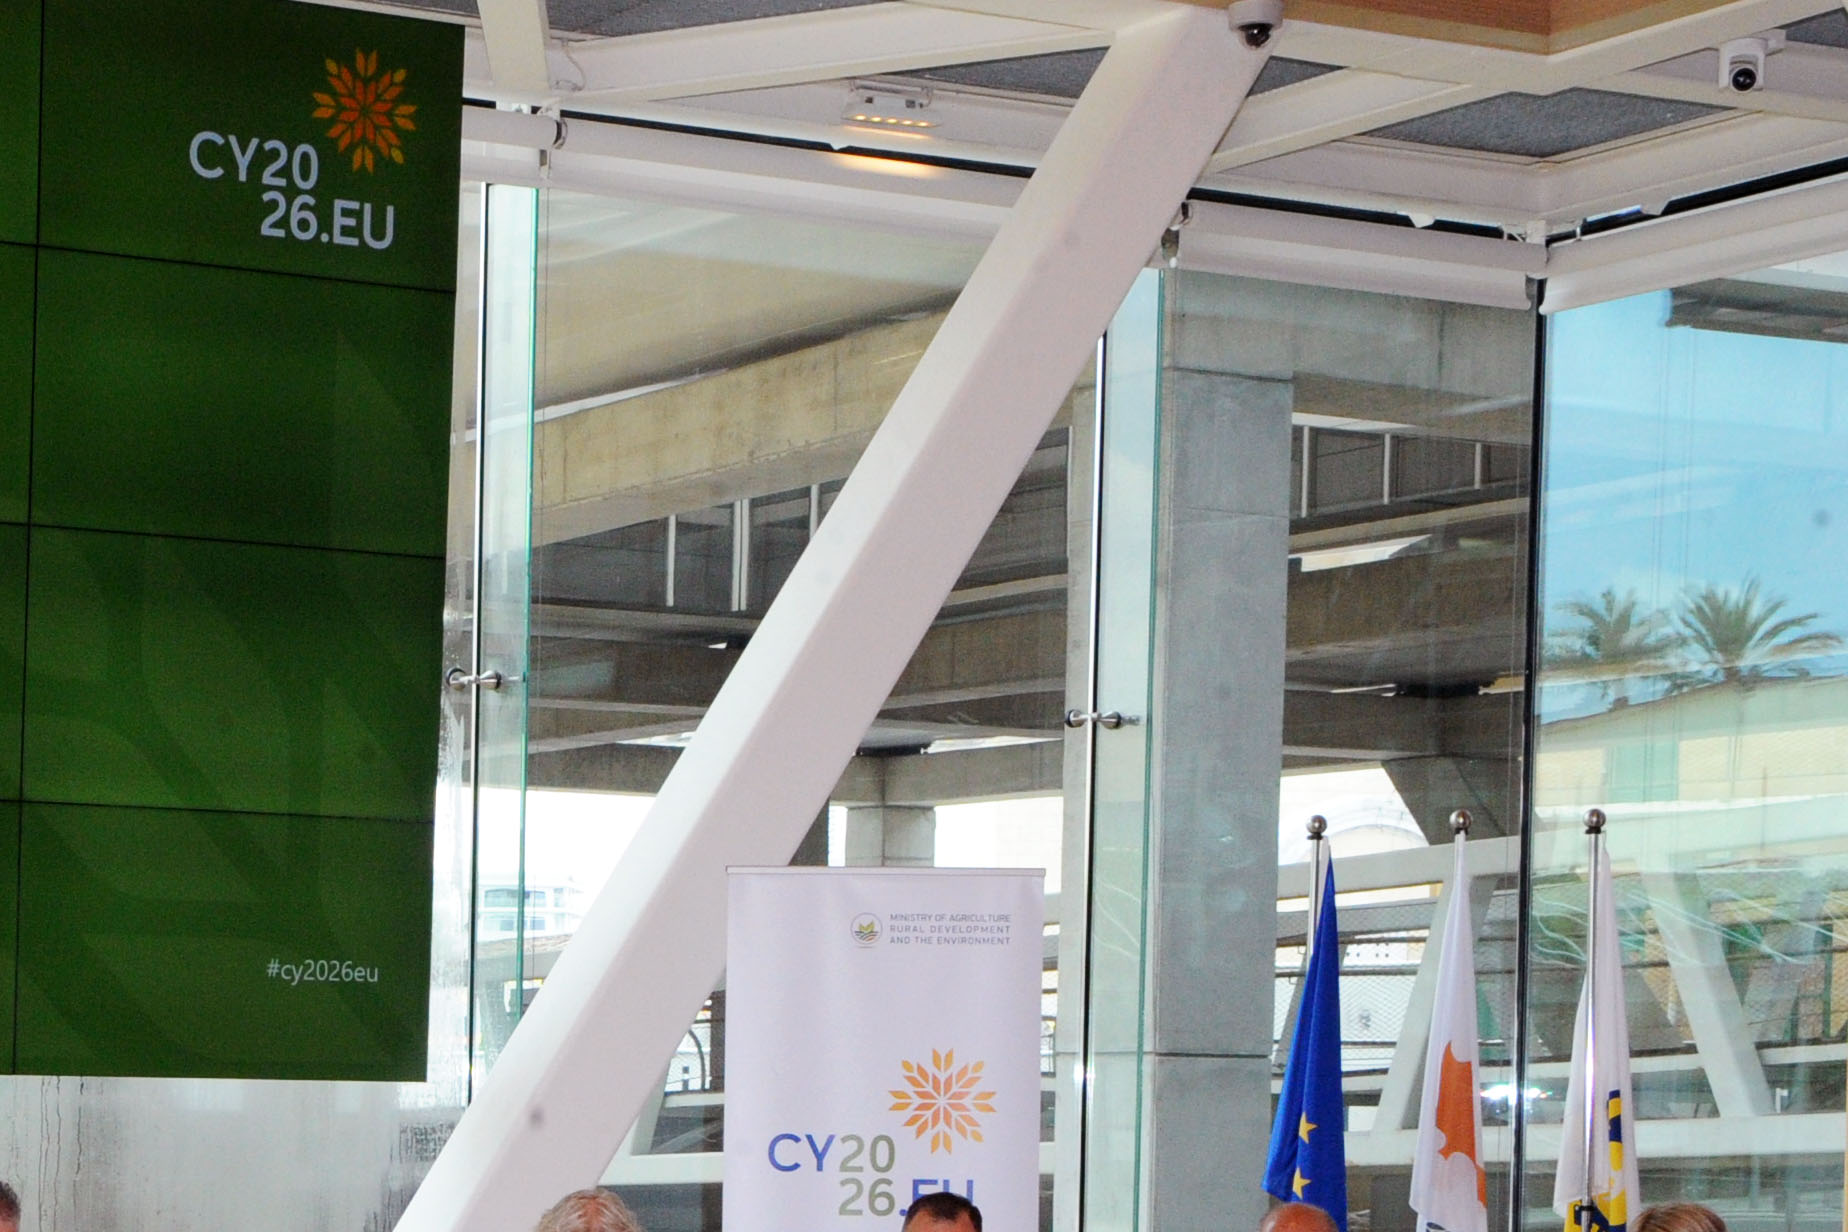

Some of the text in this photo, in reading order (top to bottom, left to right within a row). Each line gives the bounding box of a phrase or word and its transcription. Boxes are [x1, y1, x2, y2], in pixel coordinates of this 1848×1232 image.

[189, 130, 319, 190] CY20
[260, 190, 394, 250] 26.EU
[890, 913, 1012, 923] MINISTRY OF AGRICULTURE
[890, 925, 1010, 934] RURAL DEVELOPMENT
[890, 936, 1010, 945] AND THE ENVIRONMENT
[266, 958, 378, 986] #cy2026eu
[768, 1133, 896, 1173] CY20
